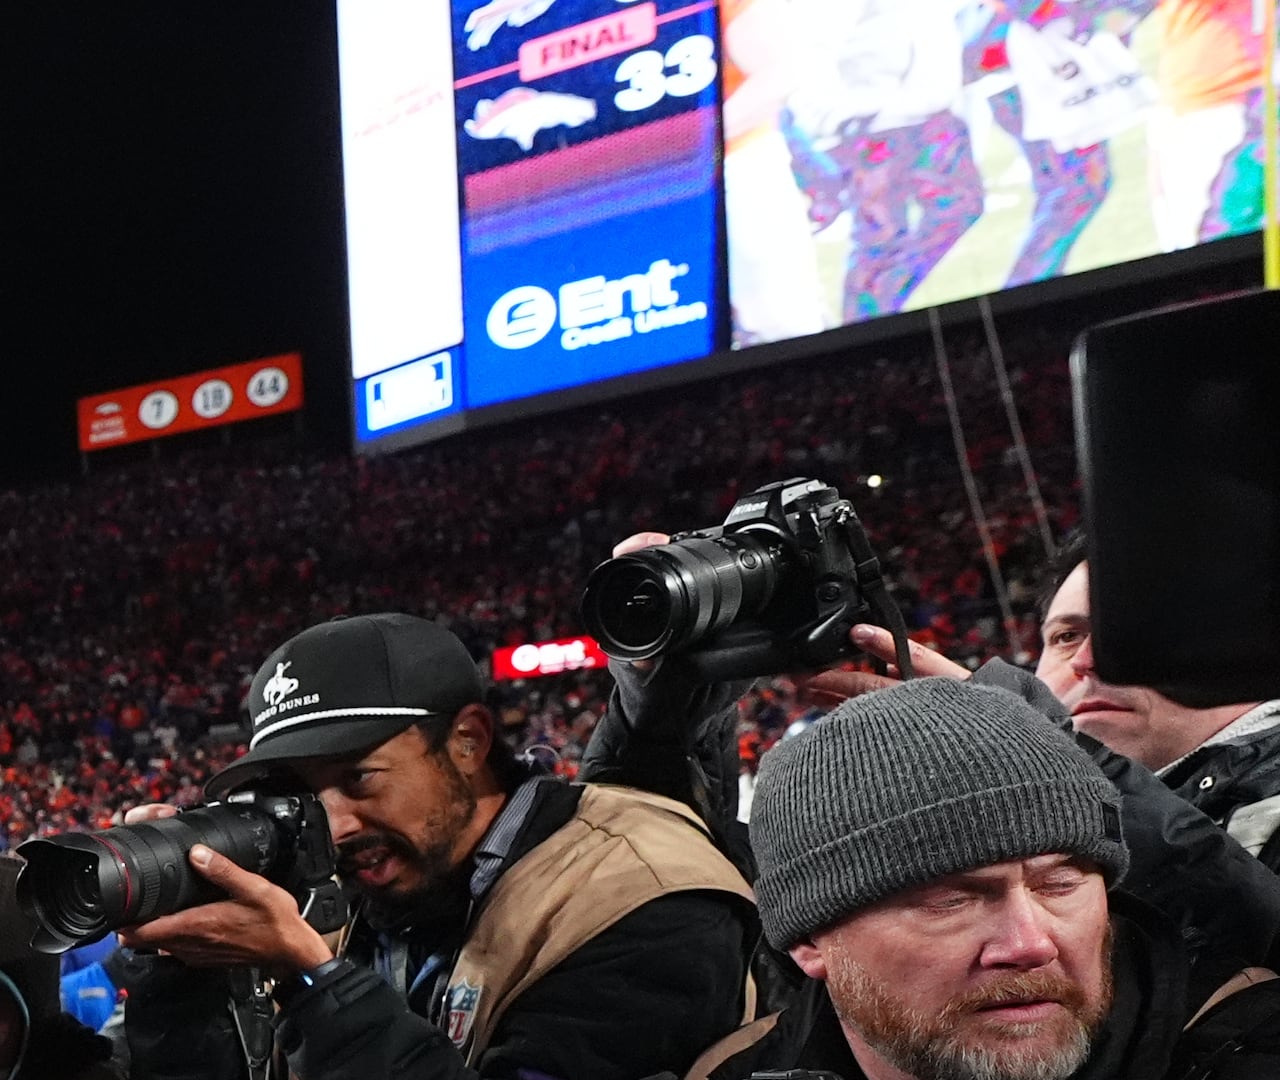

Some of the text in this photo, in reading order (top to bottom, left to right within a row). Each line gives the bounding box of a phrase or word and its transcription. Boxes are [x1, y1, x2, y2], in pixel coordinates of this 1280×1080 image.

[540, 20, 636, 67] FINAL
[614, 34, 717, 112] 33
[558, 259, 680, 330] Ent
[254, 375, 281, 397] 44
[279, 693, 320, 713] DUNES
